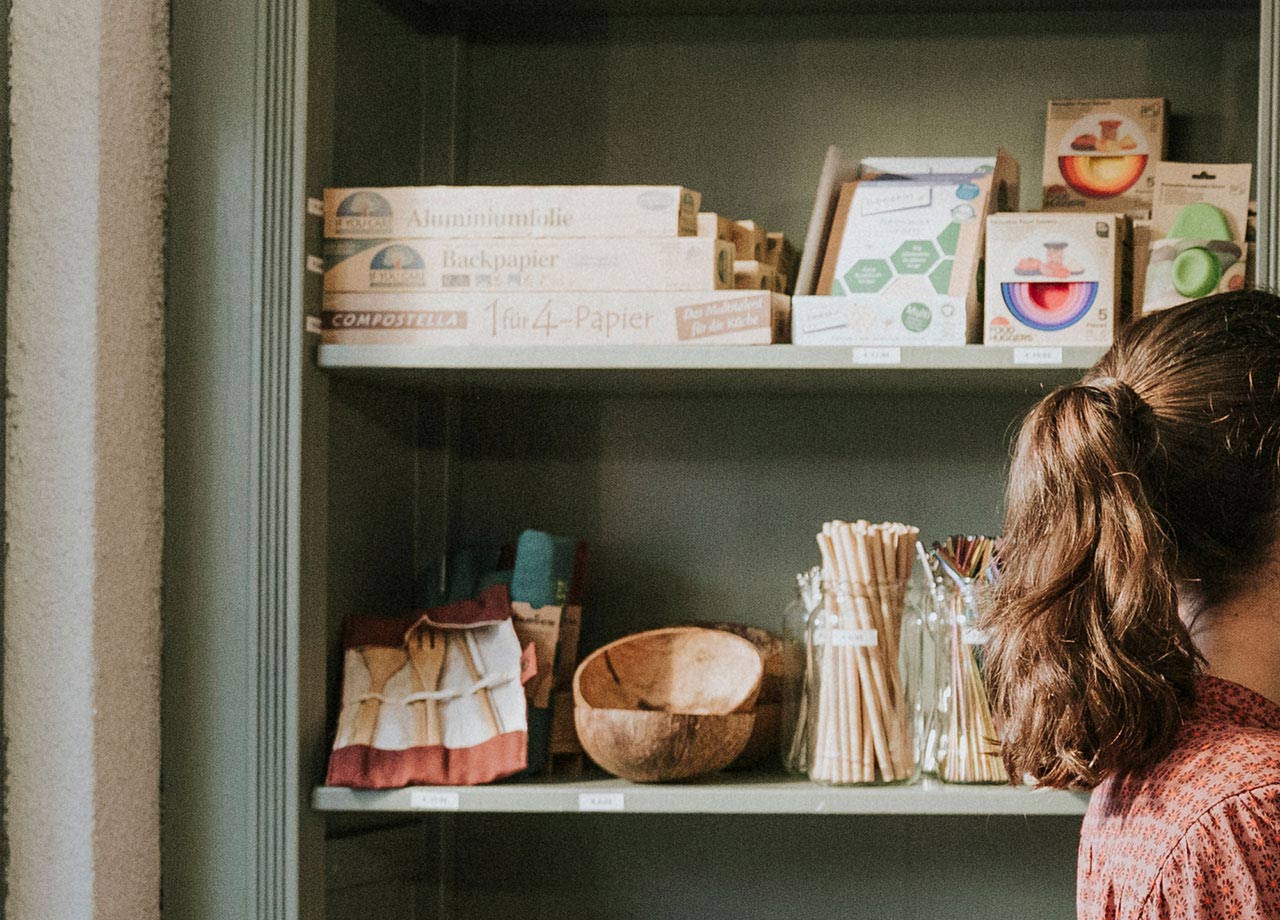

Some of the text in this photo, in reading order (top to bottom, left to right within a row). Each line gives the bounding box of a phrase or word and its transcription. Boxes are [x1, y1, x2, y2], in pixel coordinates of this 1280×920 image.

[408, 207, 574, 230] Aluminiumfolie
[442, 251, 560, 272] Backpapier
[331, 312, 459, 328] COMPOSTELLA
[485, 299, 499, 337] 1
[502, 306, 528, 331] für
[1098, 308, 1108, 321] 5
